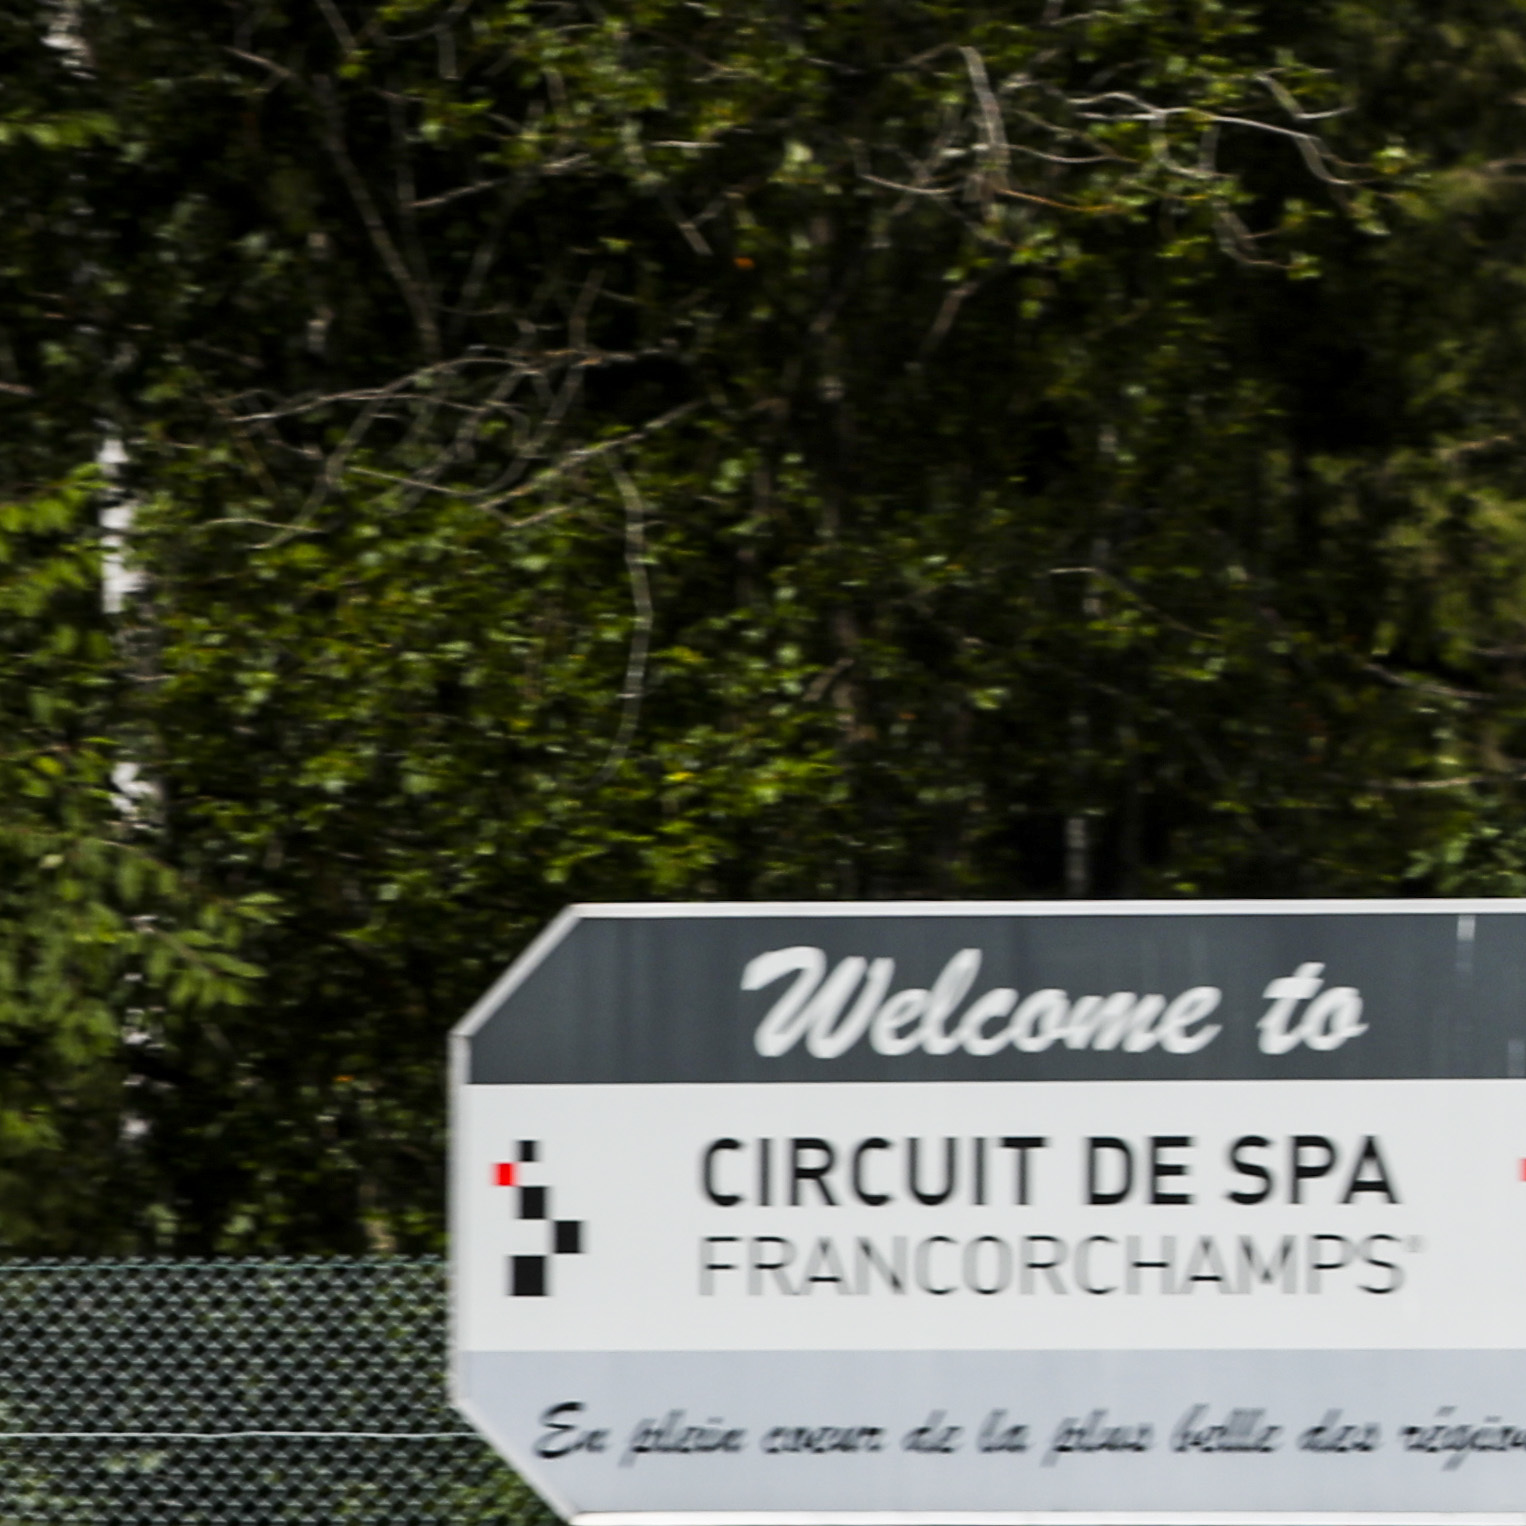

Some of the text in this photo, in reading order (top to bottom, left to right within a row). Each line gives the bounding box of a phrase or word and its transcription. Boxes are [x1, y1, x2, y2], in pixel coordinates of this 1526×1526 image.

[740, 946, 1369, 1059] Welcome to
[700, 1135, 1403, 1207] CIRCUIT DE SPA
[699, 1234, 1406, 1296] FRANCORCHAMPS
[535, 1400, 611, 1459] En
[618, 1408, 748, 1469] plain
[902, 1409, 964, 1455] de
[978, 1408, 1032, 1454] la
[1040, 1407, 1155, 1468] plus
[1170, 1403, 1284, 1454] belle
[1297, 1408, 1381, 1454] des
